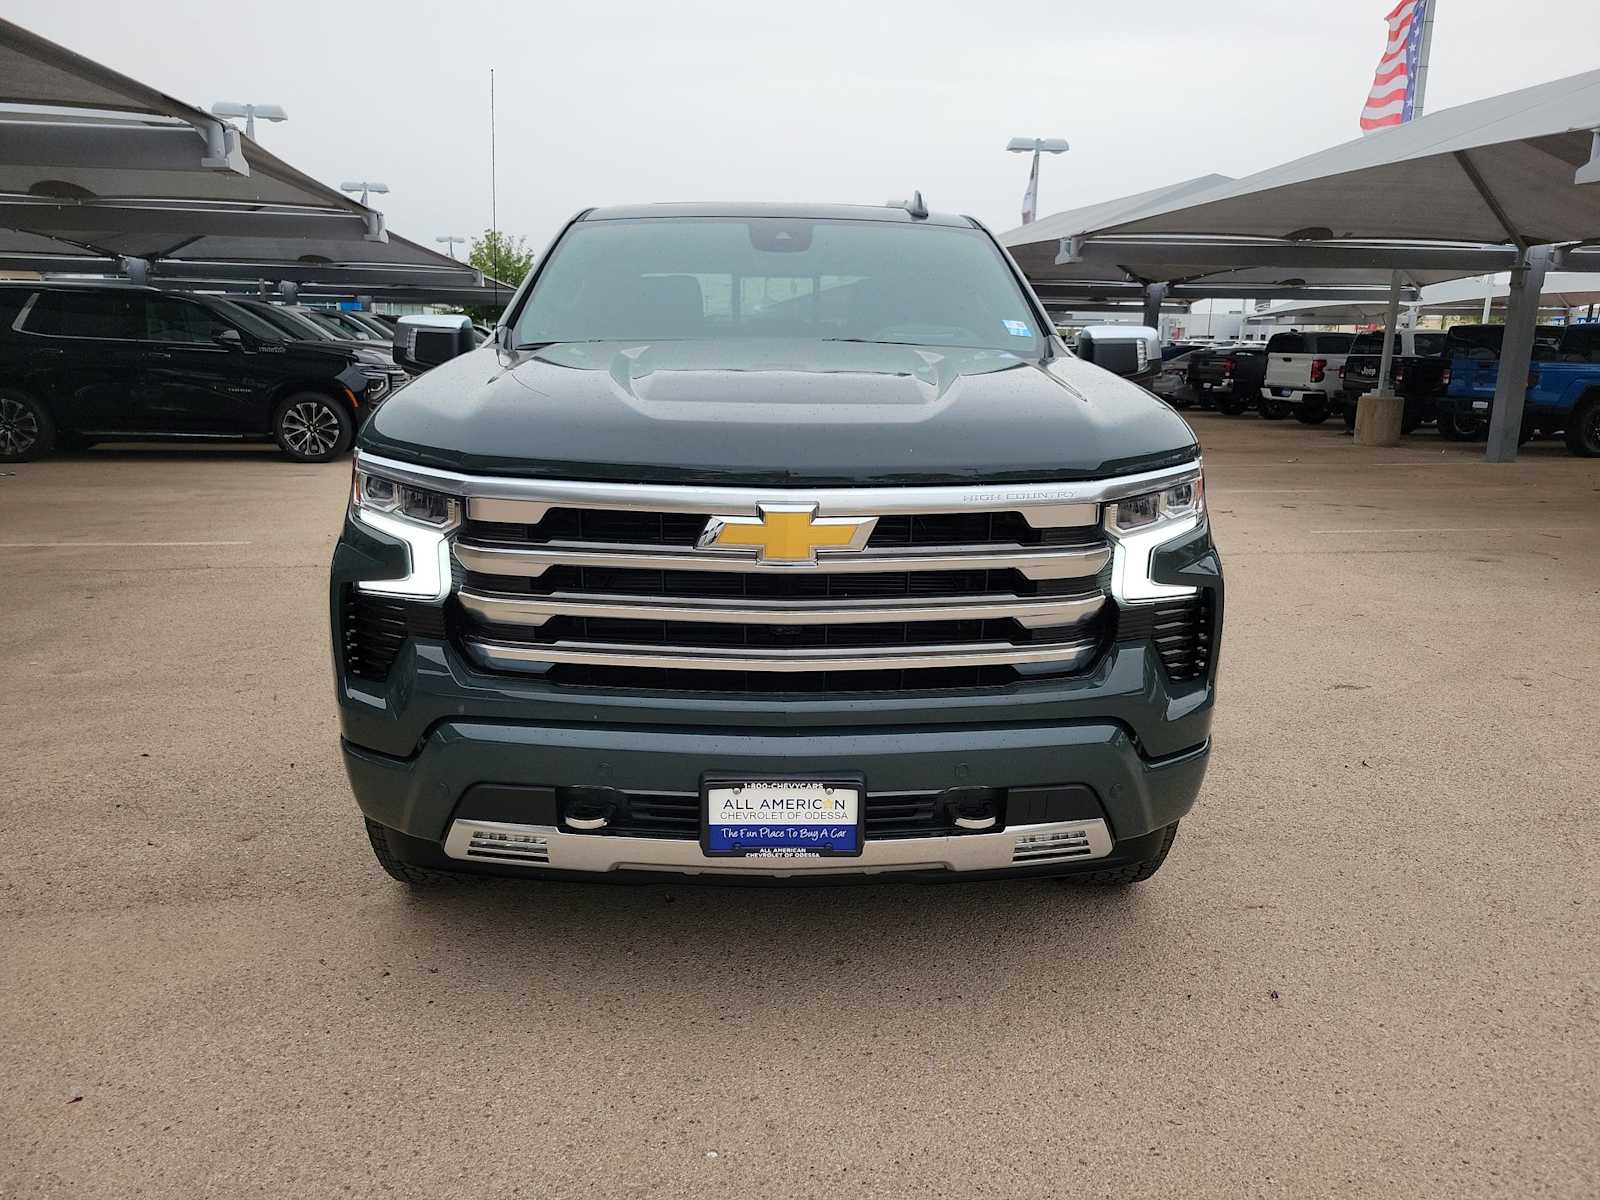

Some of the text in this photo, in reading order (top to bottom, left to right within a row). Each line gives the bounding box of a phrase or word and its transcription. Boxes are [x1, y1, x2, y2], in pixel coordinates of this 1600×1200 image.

[1361, 366, 1376, 376] Jeep
[963, 494, 1001, 503] HIGH
[723, 799, 754, 810] ALL
[720, 811, 848, 820] CHEVROLET OF ODESSA
[721, 827, 847, 841] The Fun Place To Buy A Car
